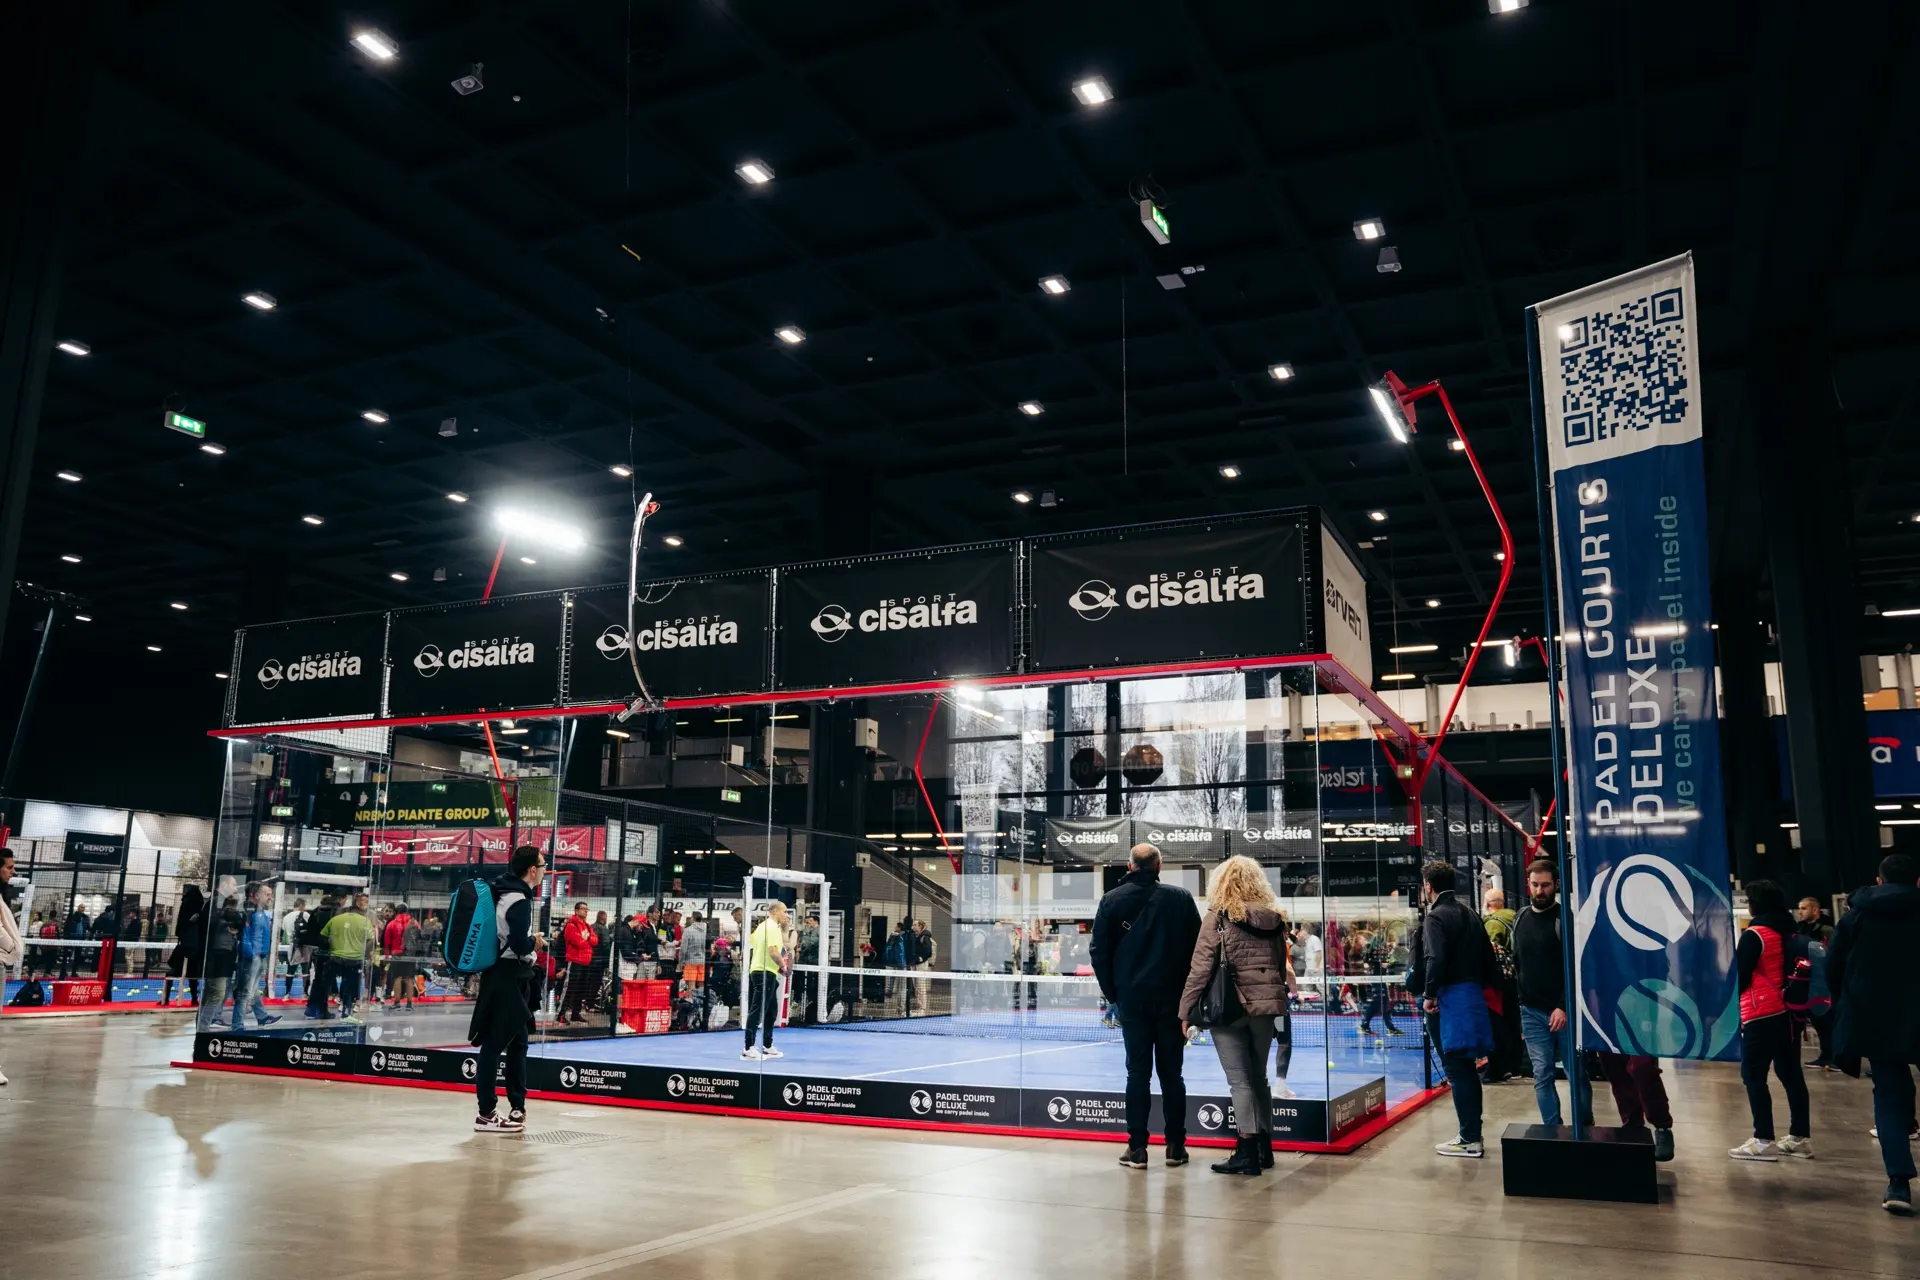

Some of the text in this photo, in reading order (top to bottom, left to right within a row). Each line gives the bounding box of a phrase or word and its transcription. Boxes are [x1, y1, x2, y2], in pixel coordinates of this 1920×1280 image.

[1160, 566, 1239, 582] SPORT
[1125, 572, 1265, 610] cisalfa
[888, 592, 957, 607] SPORT
[662, 614, 722, 627] SPORT
[858, 599, 978, 632] cisalfa
[637, 620, 738, 650] cisalfa
[471, 636, 521, 648] SPORT
[307, 650, 350, 661] SPORT
[447, 641, 535, 669] cisalfa
[1578, 477, 1620, 826] PADEL COURTS
[1654, 495, 1696, 824] we carry pael inside
[286, 655, 362, 681] cisalfa
[1626, 634, 1665, 824] DELUXE
[355, 808, 490, 821] NREMO PIANTE GROUP
[462, 922, 482, 964] KUIKMA
[70, 985, 91, 995] PADEL
[406, 1054, 428, 1062] COURTS
[580, 1068, 627, 1079] PADEL COURTS
[580, 1076, 604, 1084] DELUXE
[689, 1077, 740, 1087] PADEL COURTS
[689, 1084, 715, 1093] DELUXE
[807, 1085, 861, 1095] PADEL COURTS
[806, 1093, 835, 1101] DELUXE
[936, 1092, 996, 1103] PADEL COURTS
[936, 1101, 967, 1110] DELUXE
[1075, 1099, 1126, 1109] PADEL COU
[1075, 1108, 1110, 1117] DELUXE
[1272, 1108, 1298, 1117] URTS
